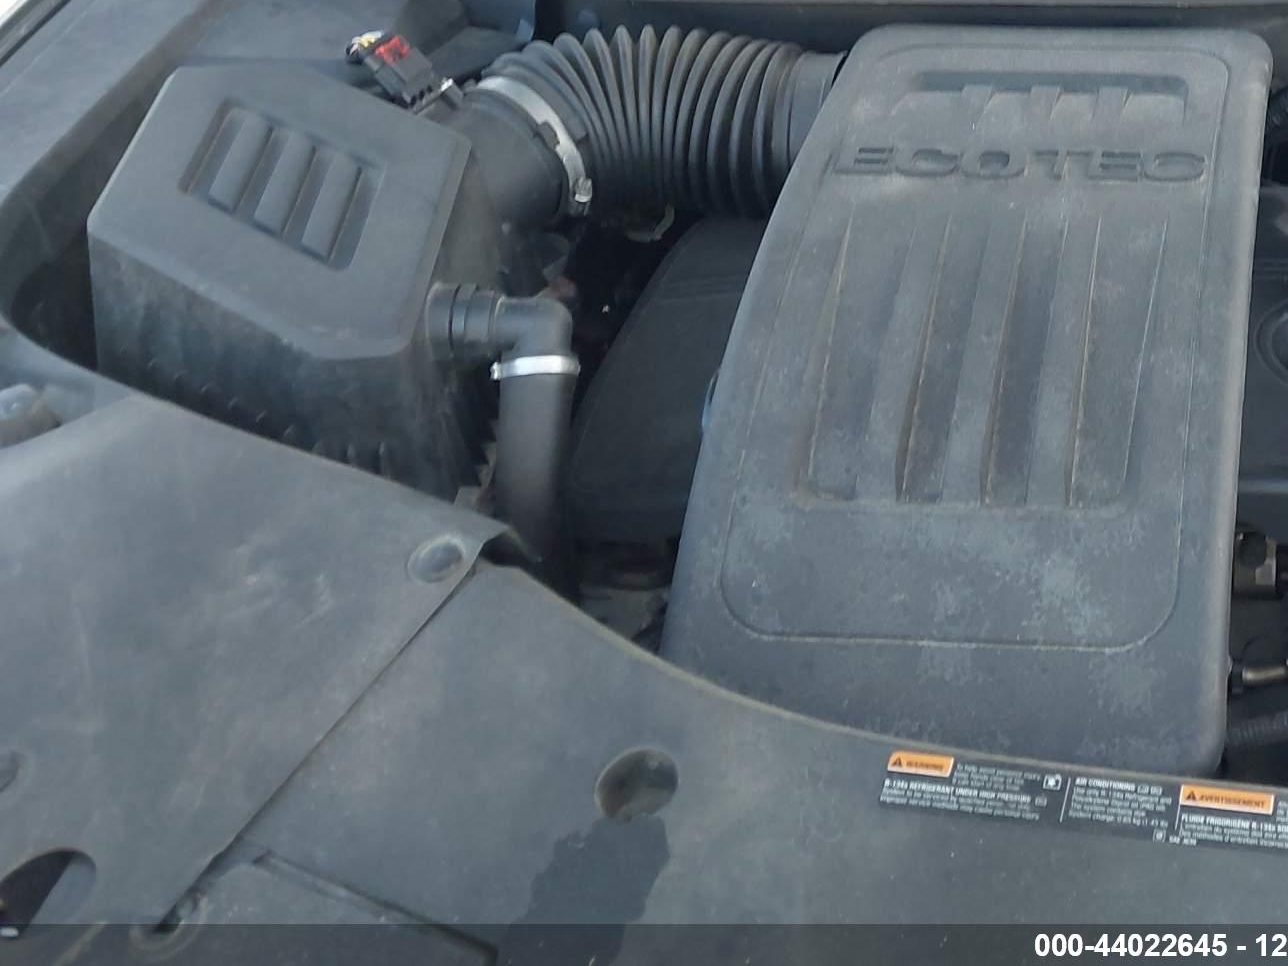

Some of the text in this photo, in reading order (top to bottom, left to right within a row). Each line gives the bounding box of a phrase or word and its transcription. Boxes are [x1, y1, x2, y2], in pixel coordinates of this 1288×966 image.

[834, 142, 1206, 183] ECOTEC
[906, 761, 944, 772] WARNING
[1199, 794, 1266, 809] AVERTISSEMENT
